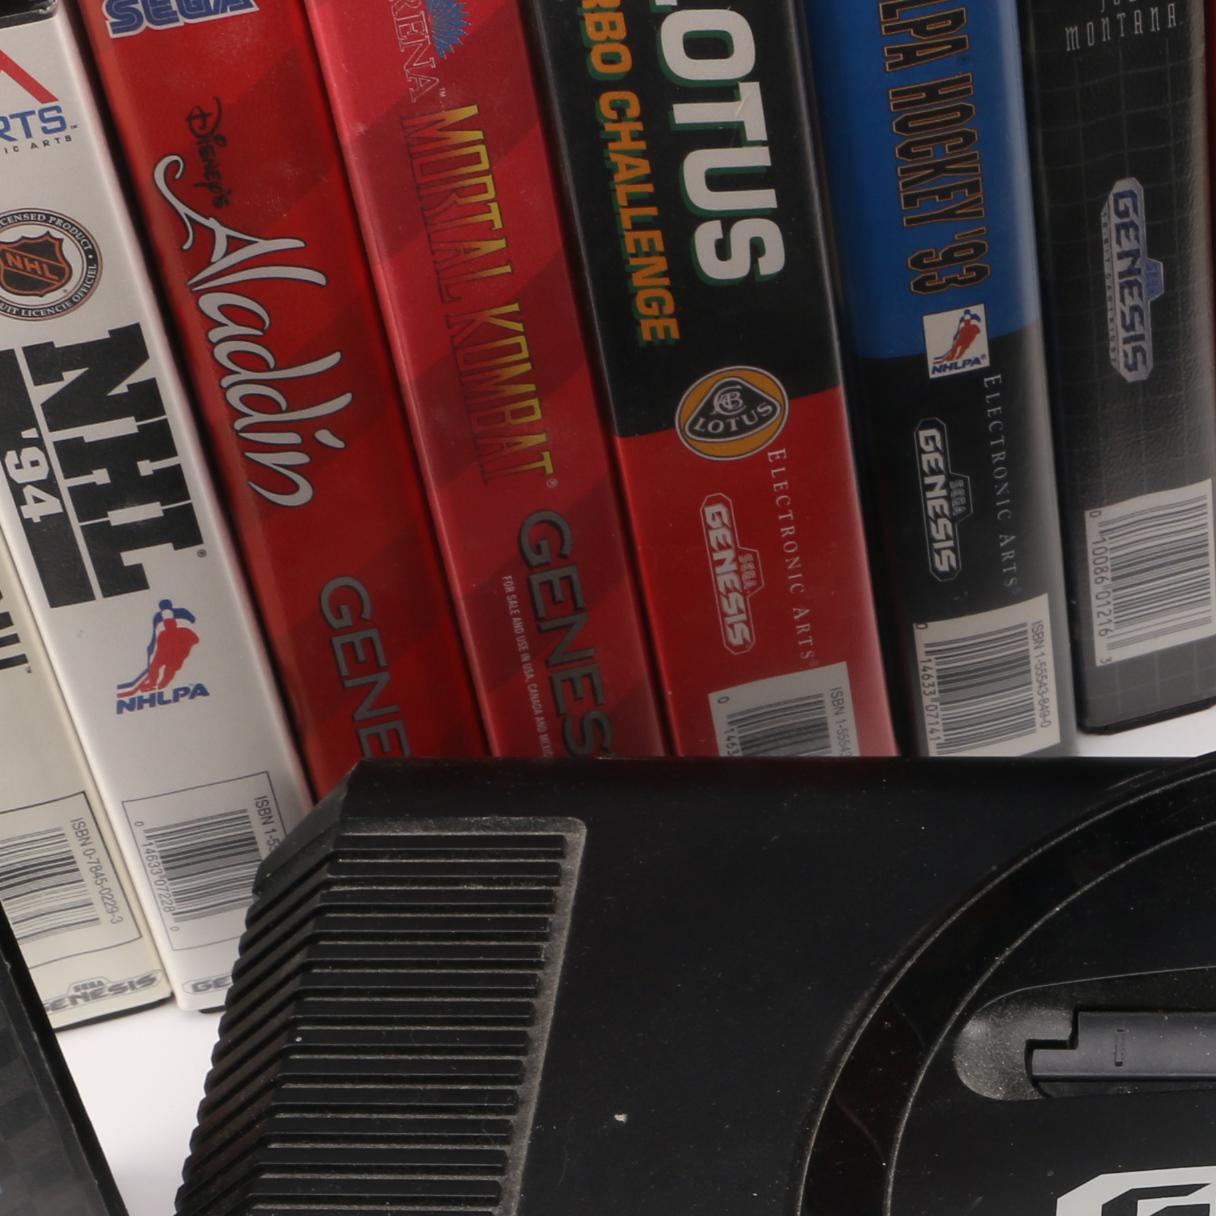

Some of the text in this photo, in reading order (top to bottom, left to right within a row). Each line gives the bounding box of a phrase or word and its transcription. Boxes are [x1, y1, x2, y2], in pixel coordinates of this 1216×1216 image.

[1064, 2, 1177, 52] MONTANA
[30, 134, 72, 150] ARTS
[581, 0, 680, 346] BO CHALLENGE
[655, 0, 786, 284] OTUS
[888, 72, 986, 228] HOCKEY
[5, 251, 61, 281] NHL
[48, 215, 94, 251] PRODUCT
[906, 226, 992, 295] '93
[401, 103, 555, 488] MORTAL KOMBAT
[1112, 189, 1148, 373] GENESIS
[153, 154, 353, 508] Aladdin
[931, 359, 980, 375] NHLPA
[694, 402, 774, 434] LOTUS
[5, 426, 64, 523] '94
[22, 322, 205, 599] NHL
[918, 428, 958, 573] GENESIS
[982, 374, 1019, 589] ELECTRONIC ARTS
[704, 502, 752, 647] GENESIS
[766, 447, 816, 661] ELECTRONIC ARTS
[116, 681, 210, 715] NHLPA
[70, 817, 88, 847] ISBN
[254, 795, 275, 826] ISBN
[142, 841, 164, 878] 14633
[152, 878, 177, 915] 07228
